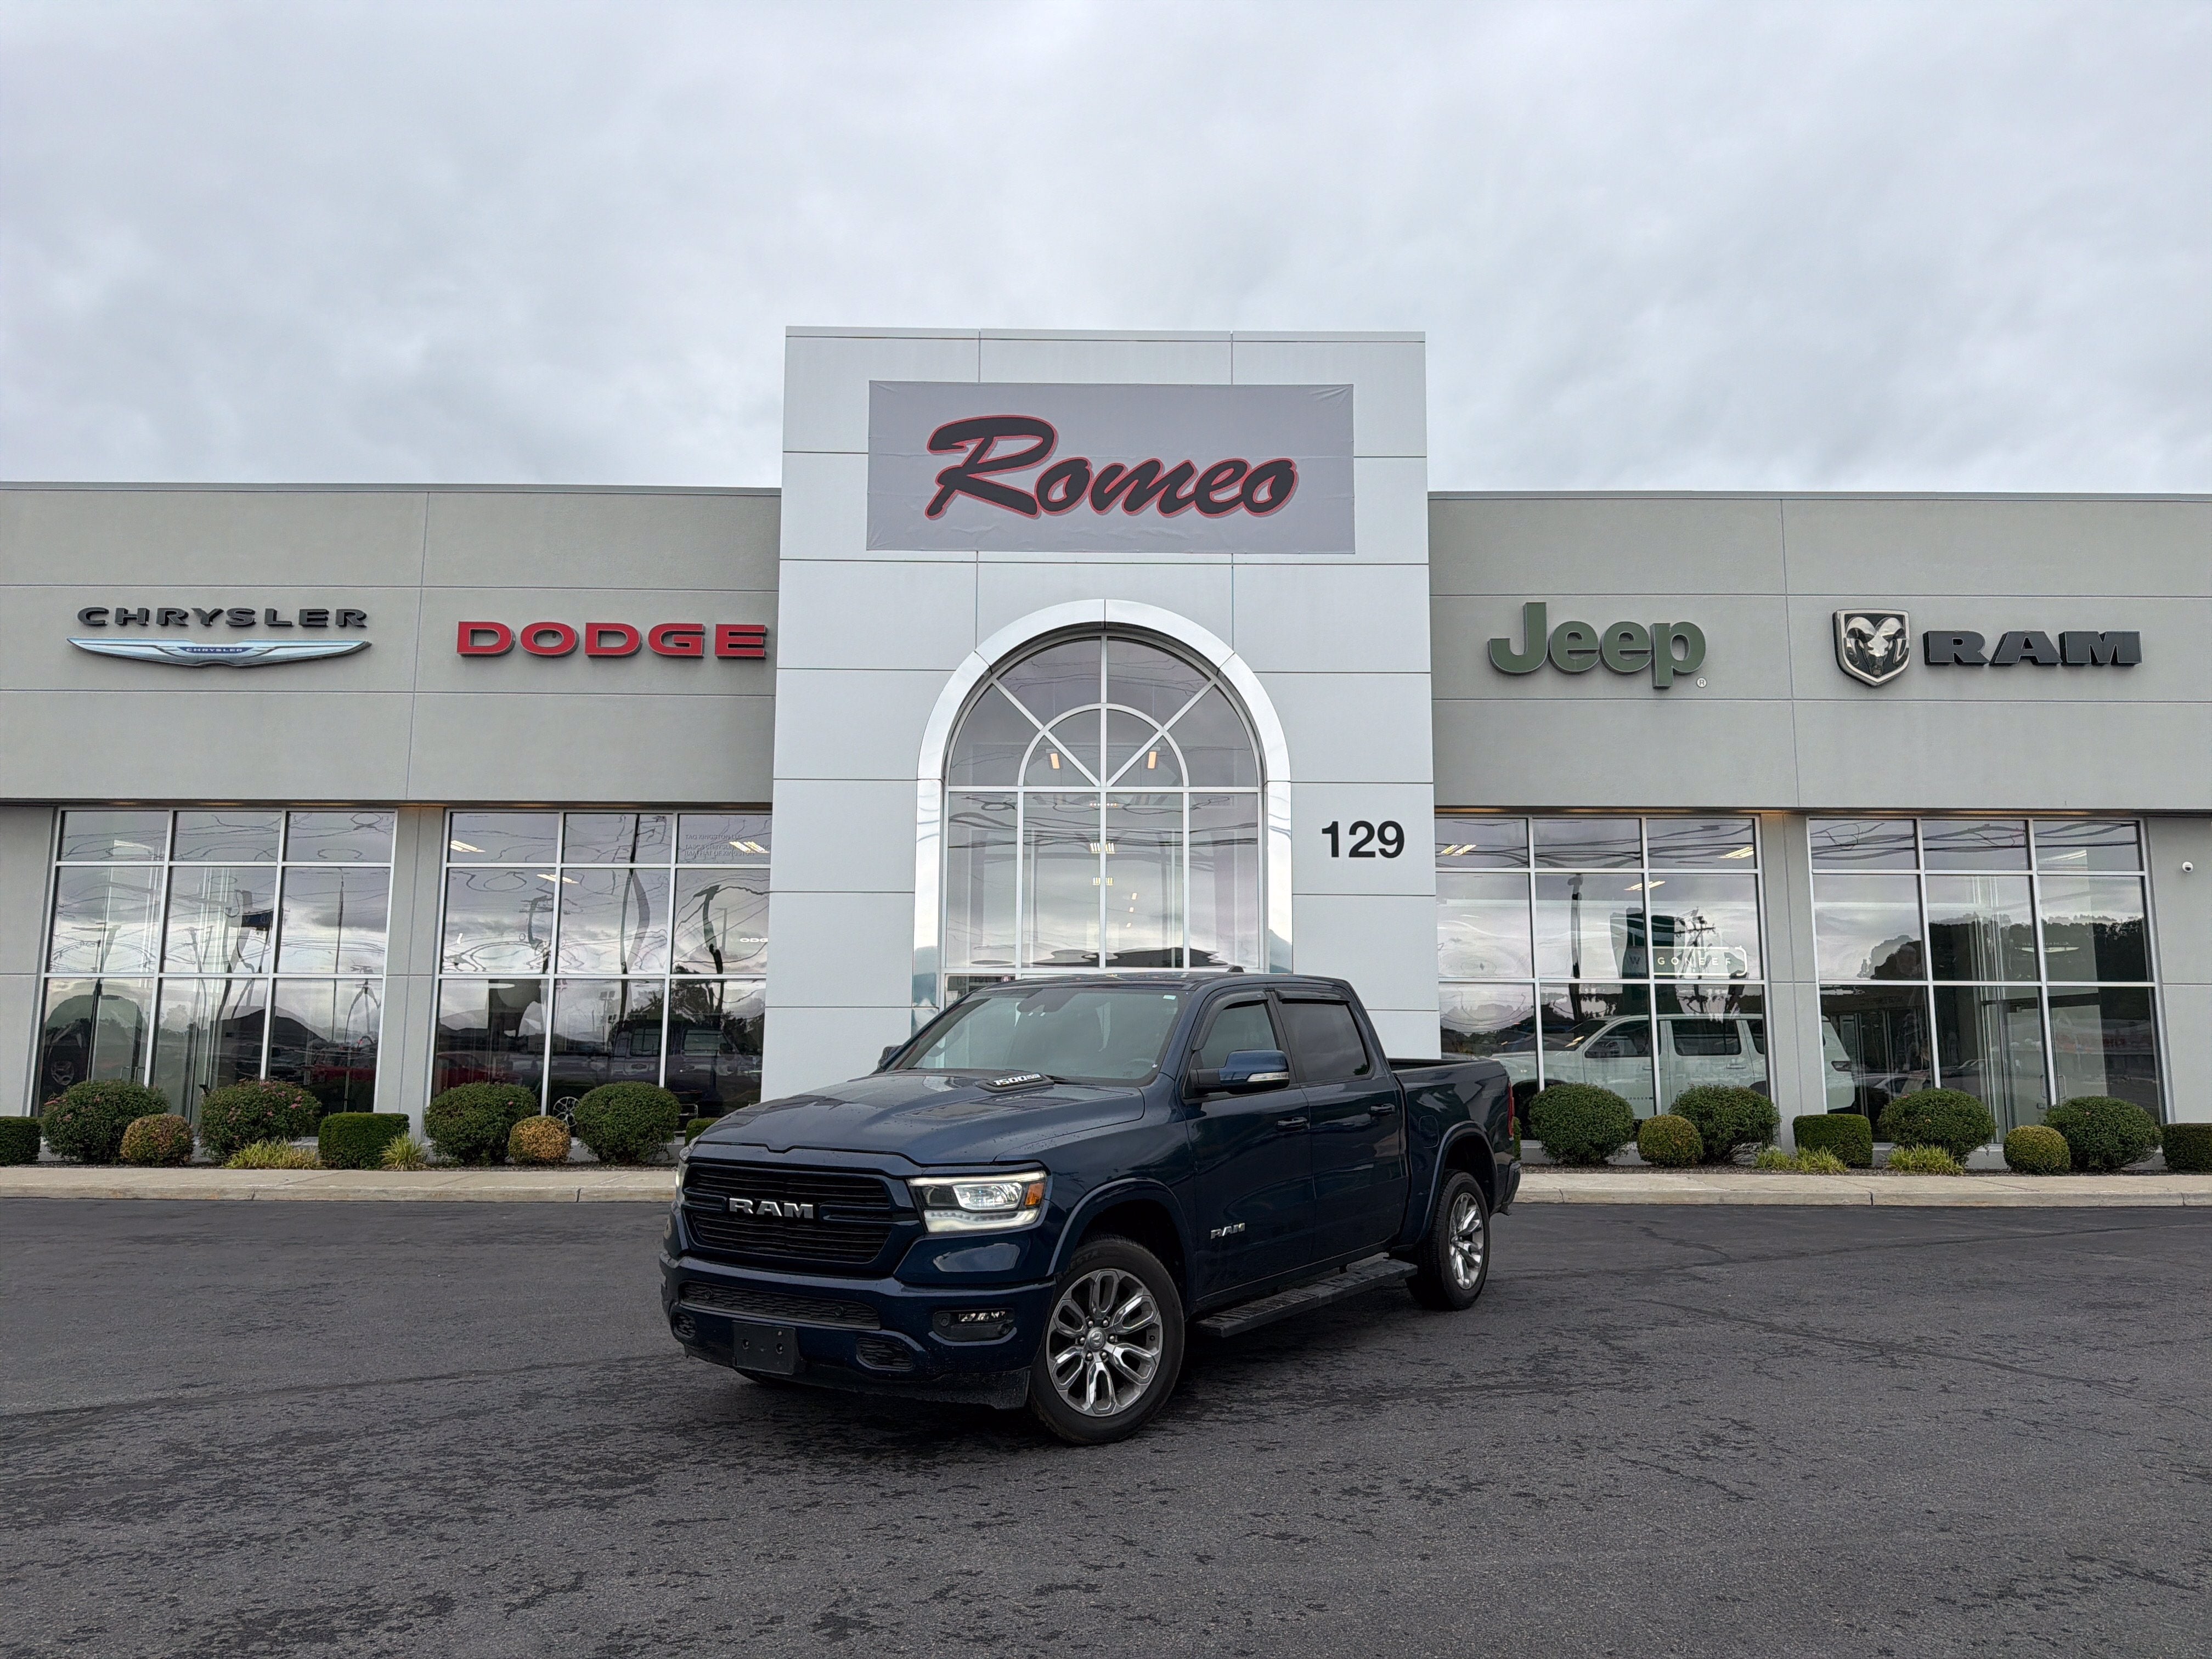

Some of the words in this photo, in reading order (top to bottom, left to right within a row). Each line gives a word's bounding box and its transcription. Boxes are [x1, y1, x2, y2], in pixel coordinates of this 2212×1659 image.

[925, 415, 1298, 519] Romeo
[77, 607, 368, 628] CHRYSLER
[456, 620, 767, 658] DODGE
[1487, 602, 1706, 689] Jeep
[1923, 630, 2142, 667] RAM
[1321, 820, 1405, 859] 129
[993, 1076, 1027, 1085] 1500
[729, 1198, 814, 1219] RAM
[1210, 1223, 1245, 1240] RAM
